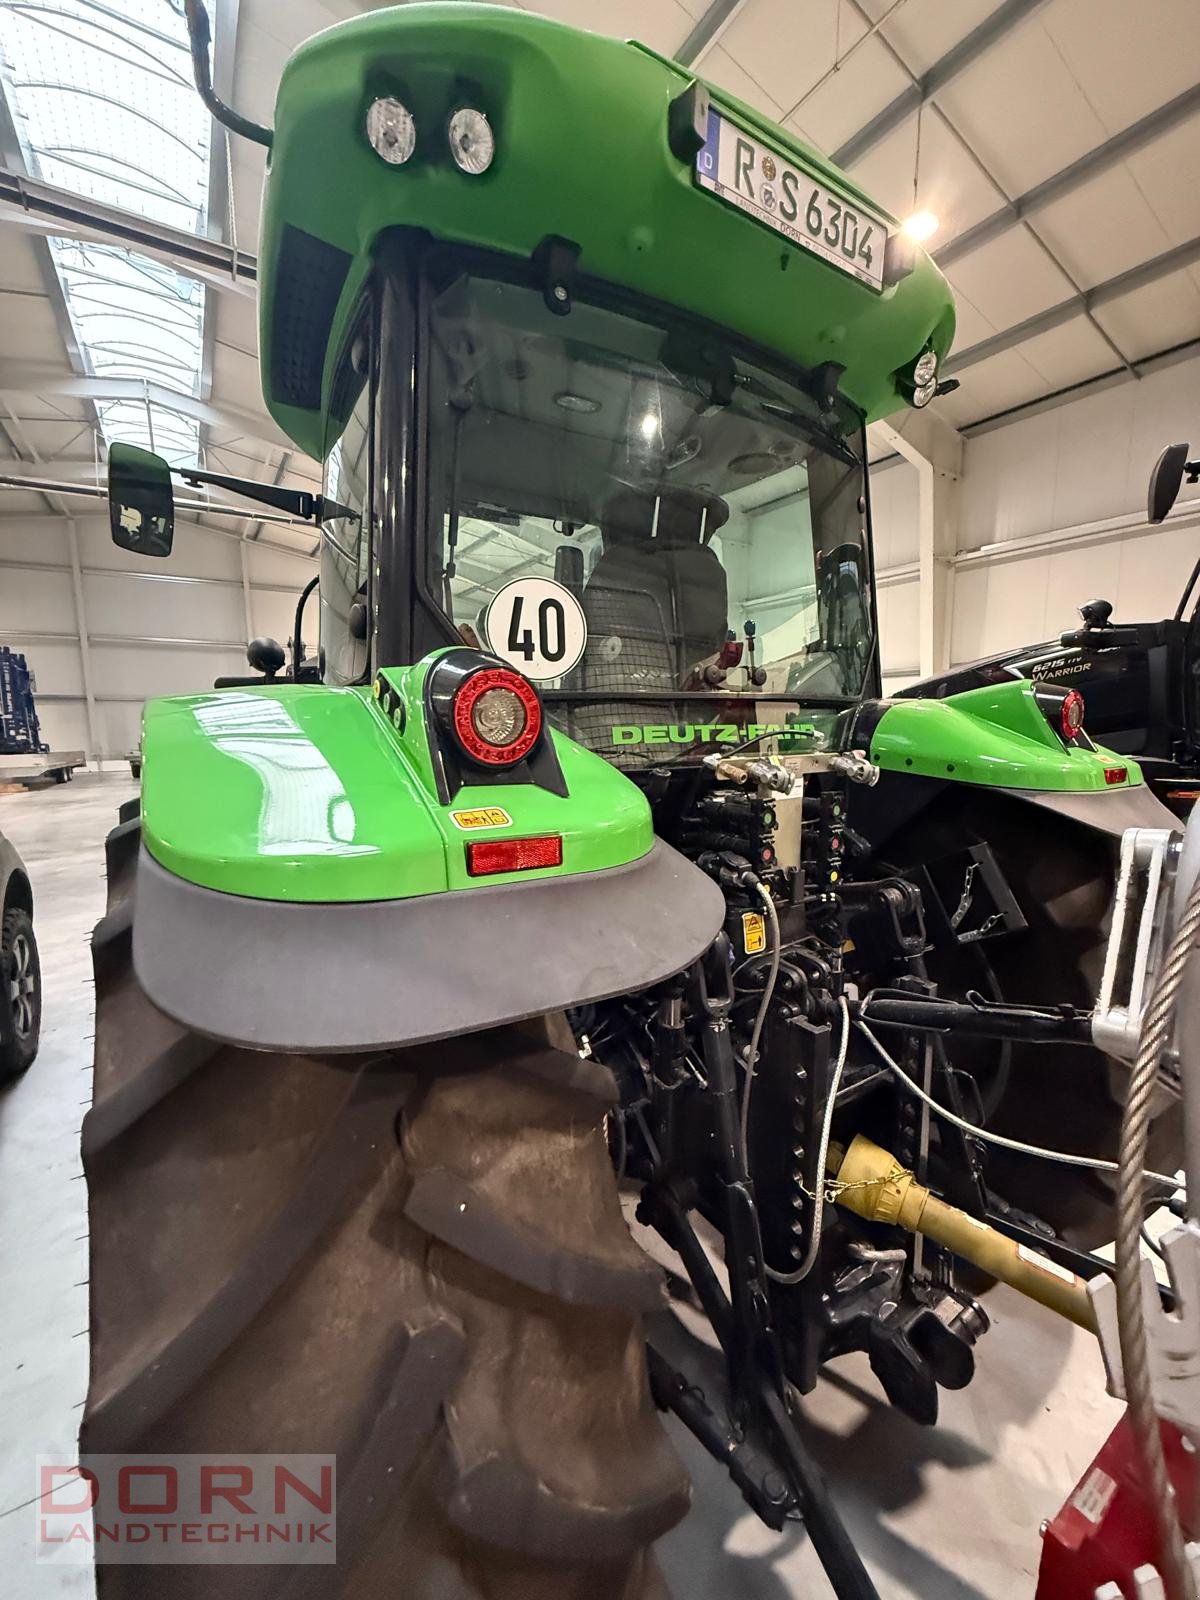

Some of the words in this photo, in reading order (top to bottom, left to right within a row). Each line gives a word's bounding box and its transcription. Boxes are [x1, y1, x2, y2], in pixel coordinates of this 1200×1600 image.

[704, 152, 713, 170] D
[735, 138, 755, 199] R
[806, 190, 873, 270] 6304
[781, 222, 801, 242] DORN
[508, 596, 566, 662] 40
[1032, 658, 1065, 673] 6215
[1032, 663, 1091, 681] WARRIOR
